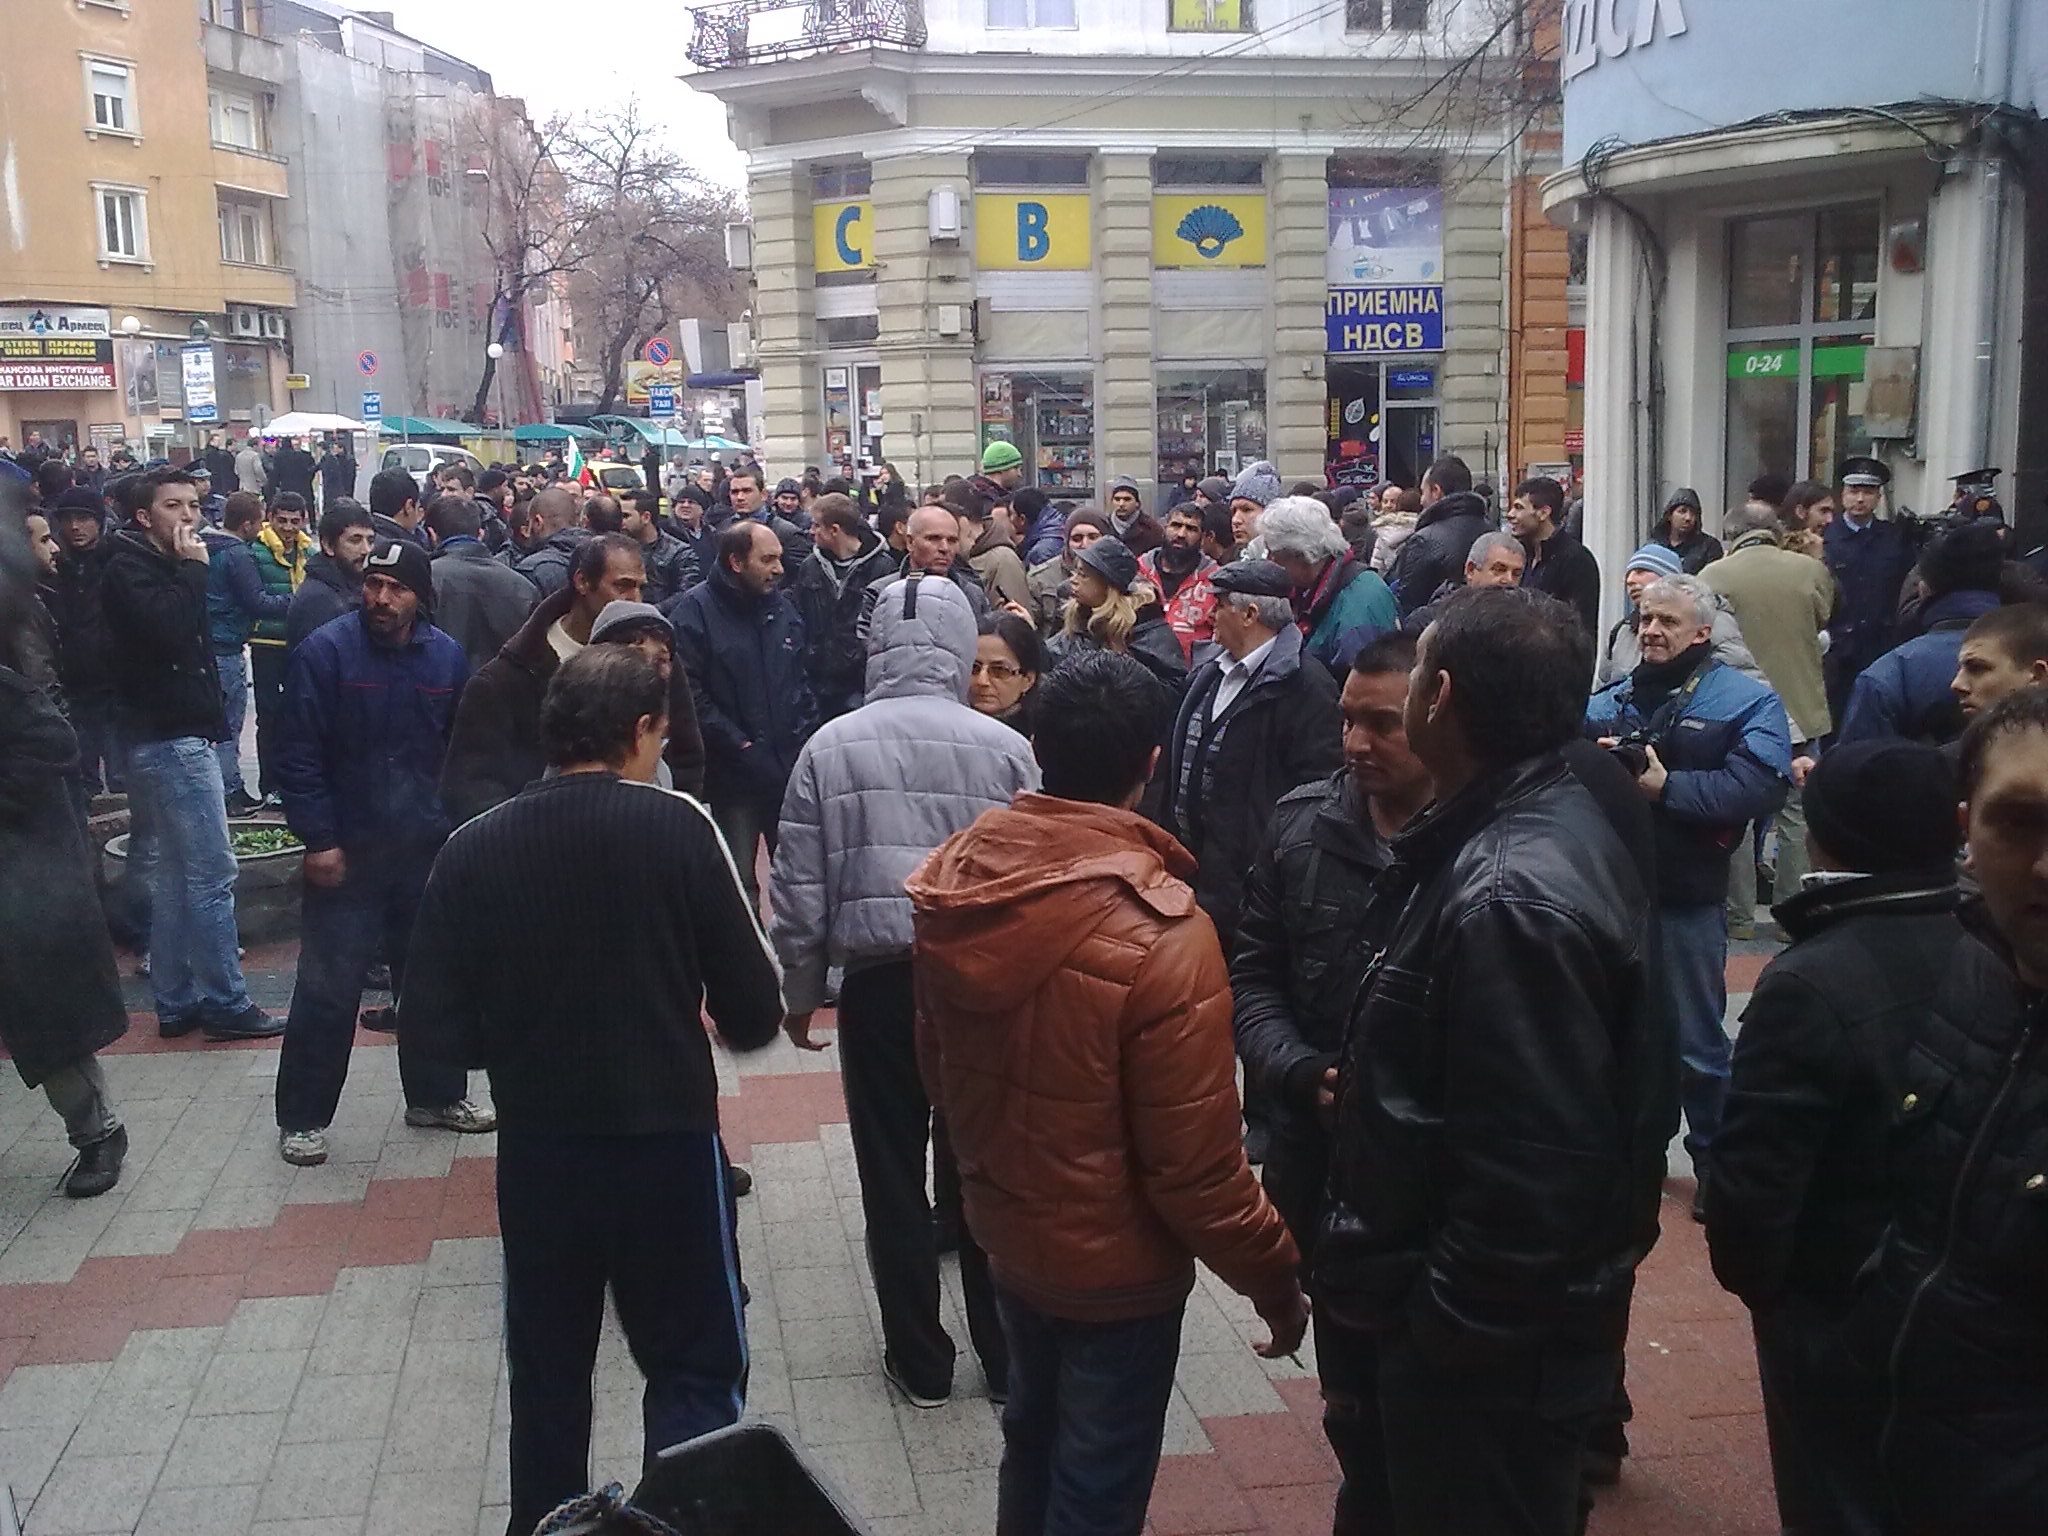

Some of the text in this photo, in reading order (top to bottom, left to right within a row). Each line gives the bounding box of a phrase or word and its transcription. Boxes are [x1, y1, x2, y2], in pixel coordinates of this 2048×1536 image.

[1327, 289, 1440, 315] ПРИЕМНА
[58, 316, 107, 333] Армеец
[1343, 322, 1424, 350] НДСВ
[45, 365, 105, 374] ИНСТИТУЦИЯ
[1746, 354, 1782, 373] 0-24
[16, 375, 49, 387] LOAN
[53, 375, 112, 387] EXCHANGE
